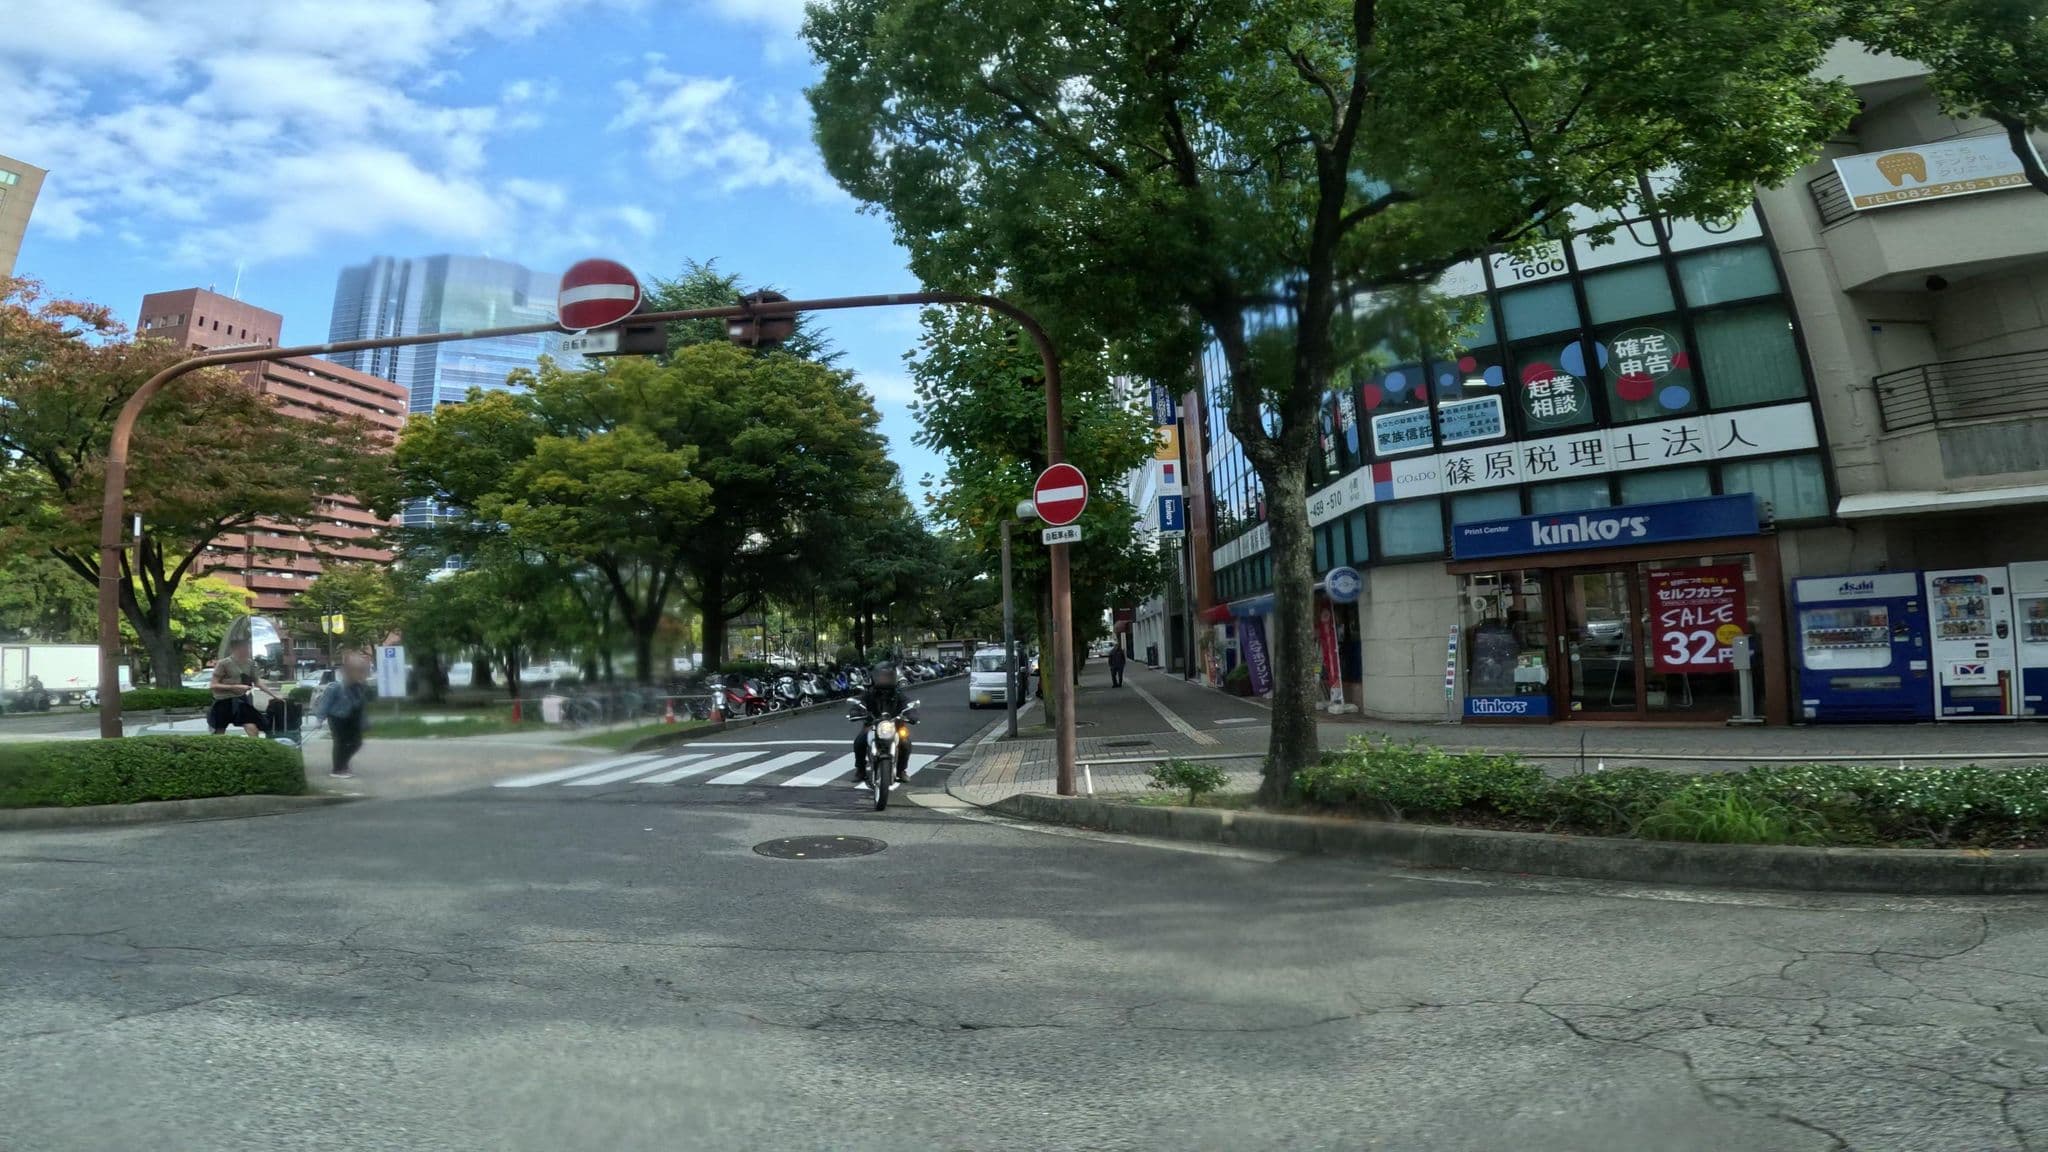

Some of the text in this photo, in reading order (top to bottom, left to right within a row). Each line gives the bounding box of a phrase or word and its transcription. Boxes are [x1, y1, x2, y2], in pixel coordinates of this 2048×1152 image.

[1866, 194, 1890, 206] TEL
[1512, 259, 1565, 280] 1600
[1614, 334, 1668, 358] 確定
[1620, 354, 1671, 377] 申告
[1528, 375, 1575, 399] 起業
[1531, 394, 1578, 418] 相談
[1377, 425, 1432, 445] 家族信託
[1445, 418, 1759, 486] 篠原税理士法人
[1464, 525, 1510, 536] Print Center
[1531, 515, 1647, 547] kinko's
[1656, 586, 1737, 600] セルフカラー
[1838, 580, 1874, 591] Asahi
[1660, 603, 1734, 628] SALE
[1472, 698, 1528, 714] kinko's
